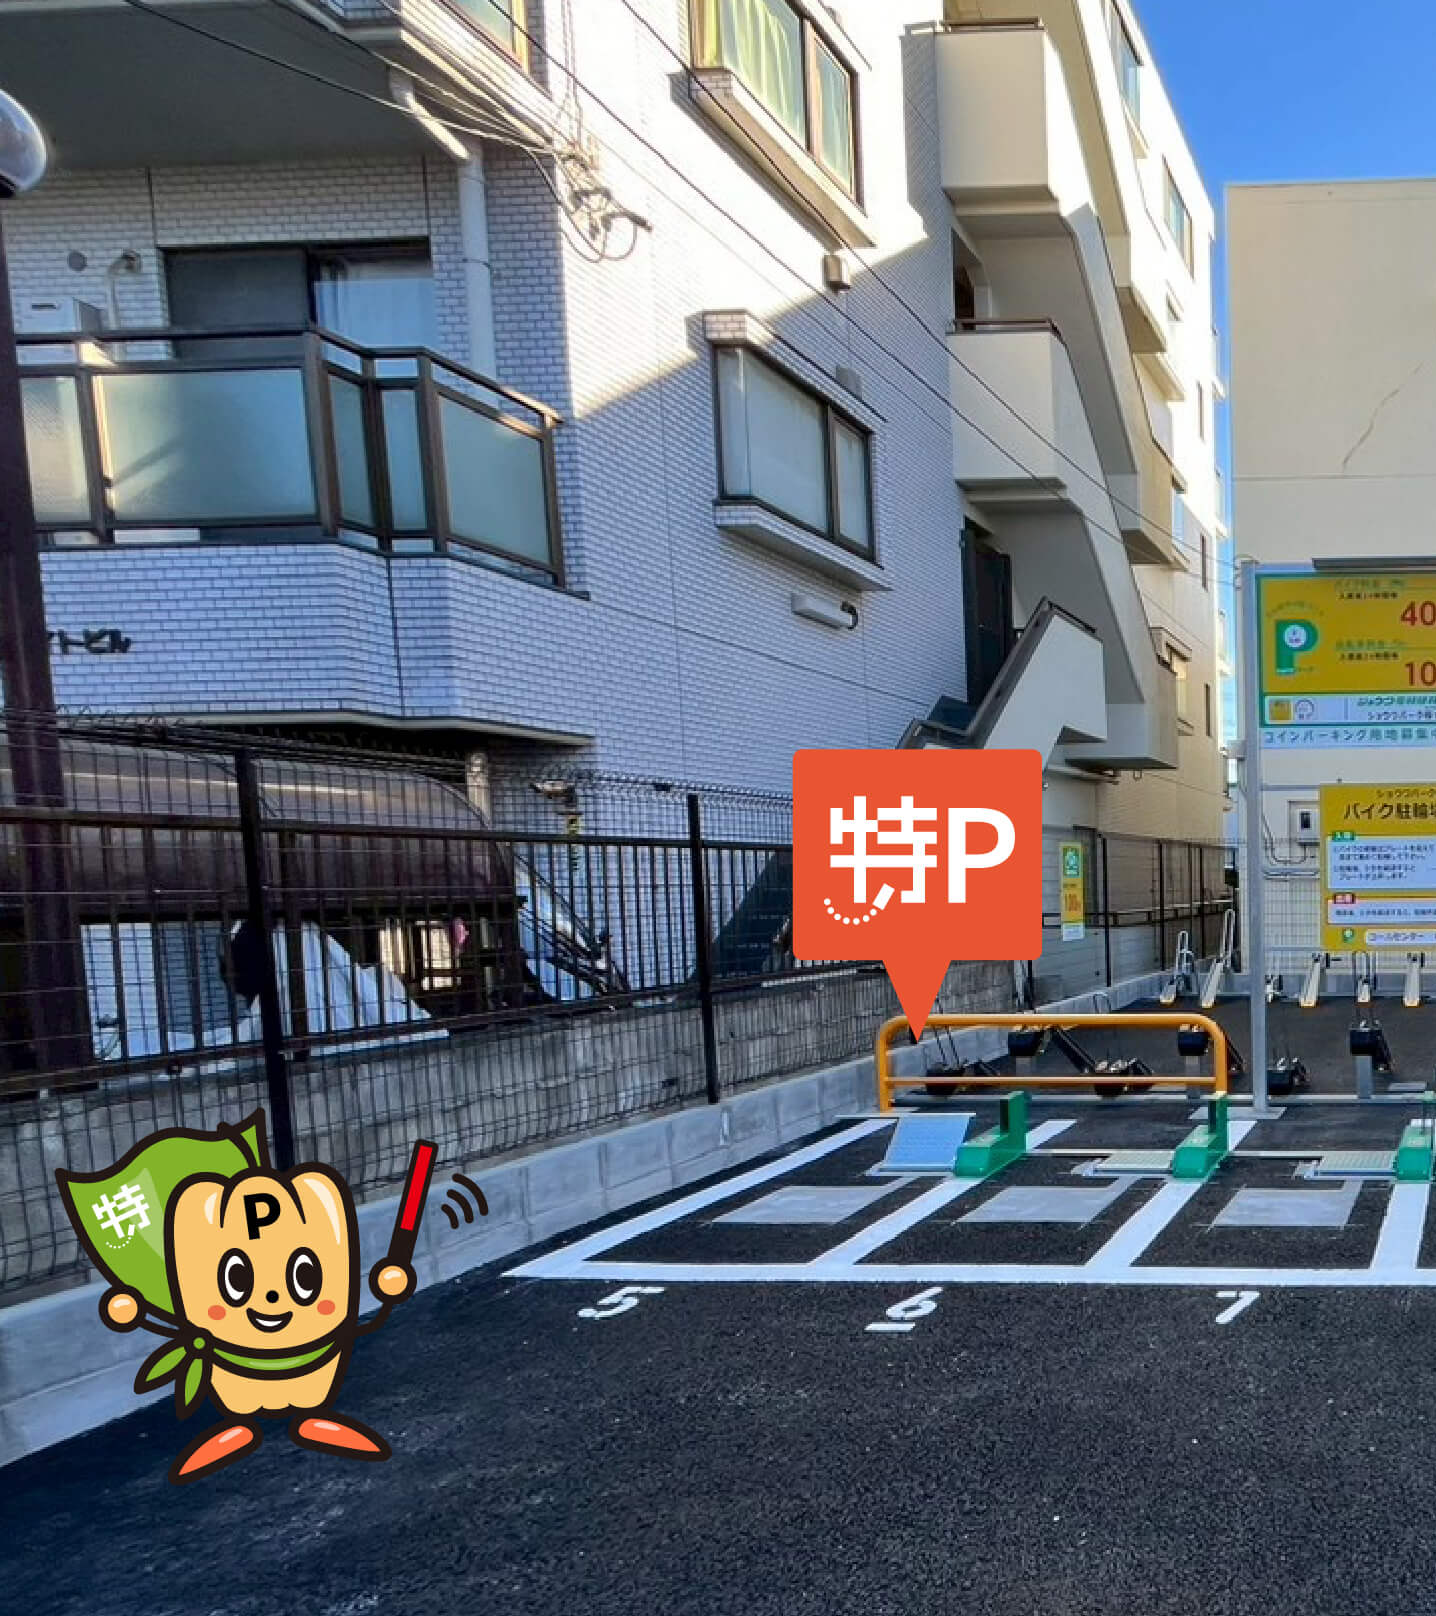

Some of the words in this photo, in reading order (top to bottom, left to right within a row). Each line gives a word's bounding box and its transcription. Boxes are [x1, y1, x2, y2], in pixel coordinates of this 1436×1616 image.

[577, 1286, 665, 1318] 5
[886, 1286, 943, 1321] 6
[1215, 1290, 1261, 1325] 7
